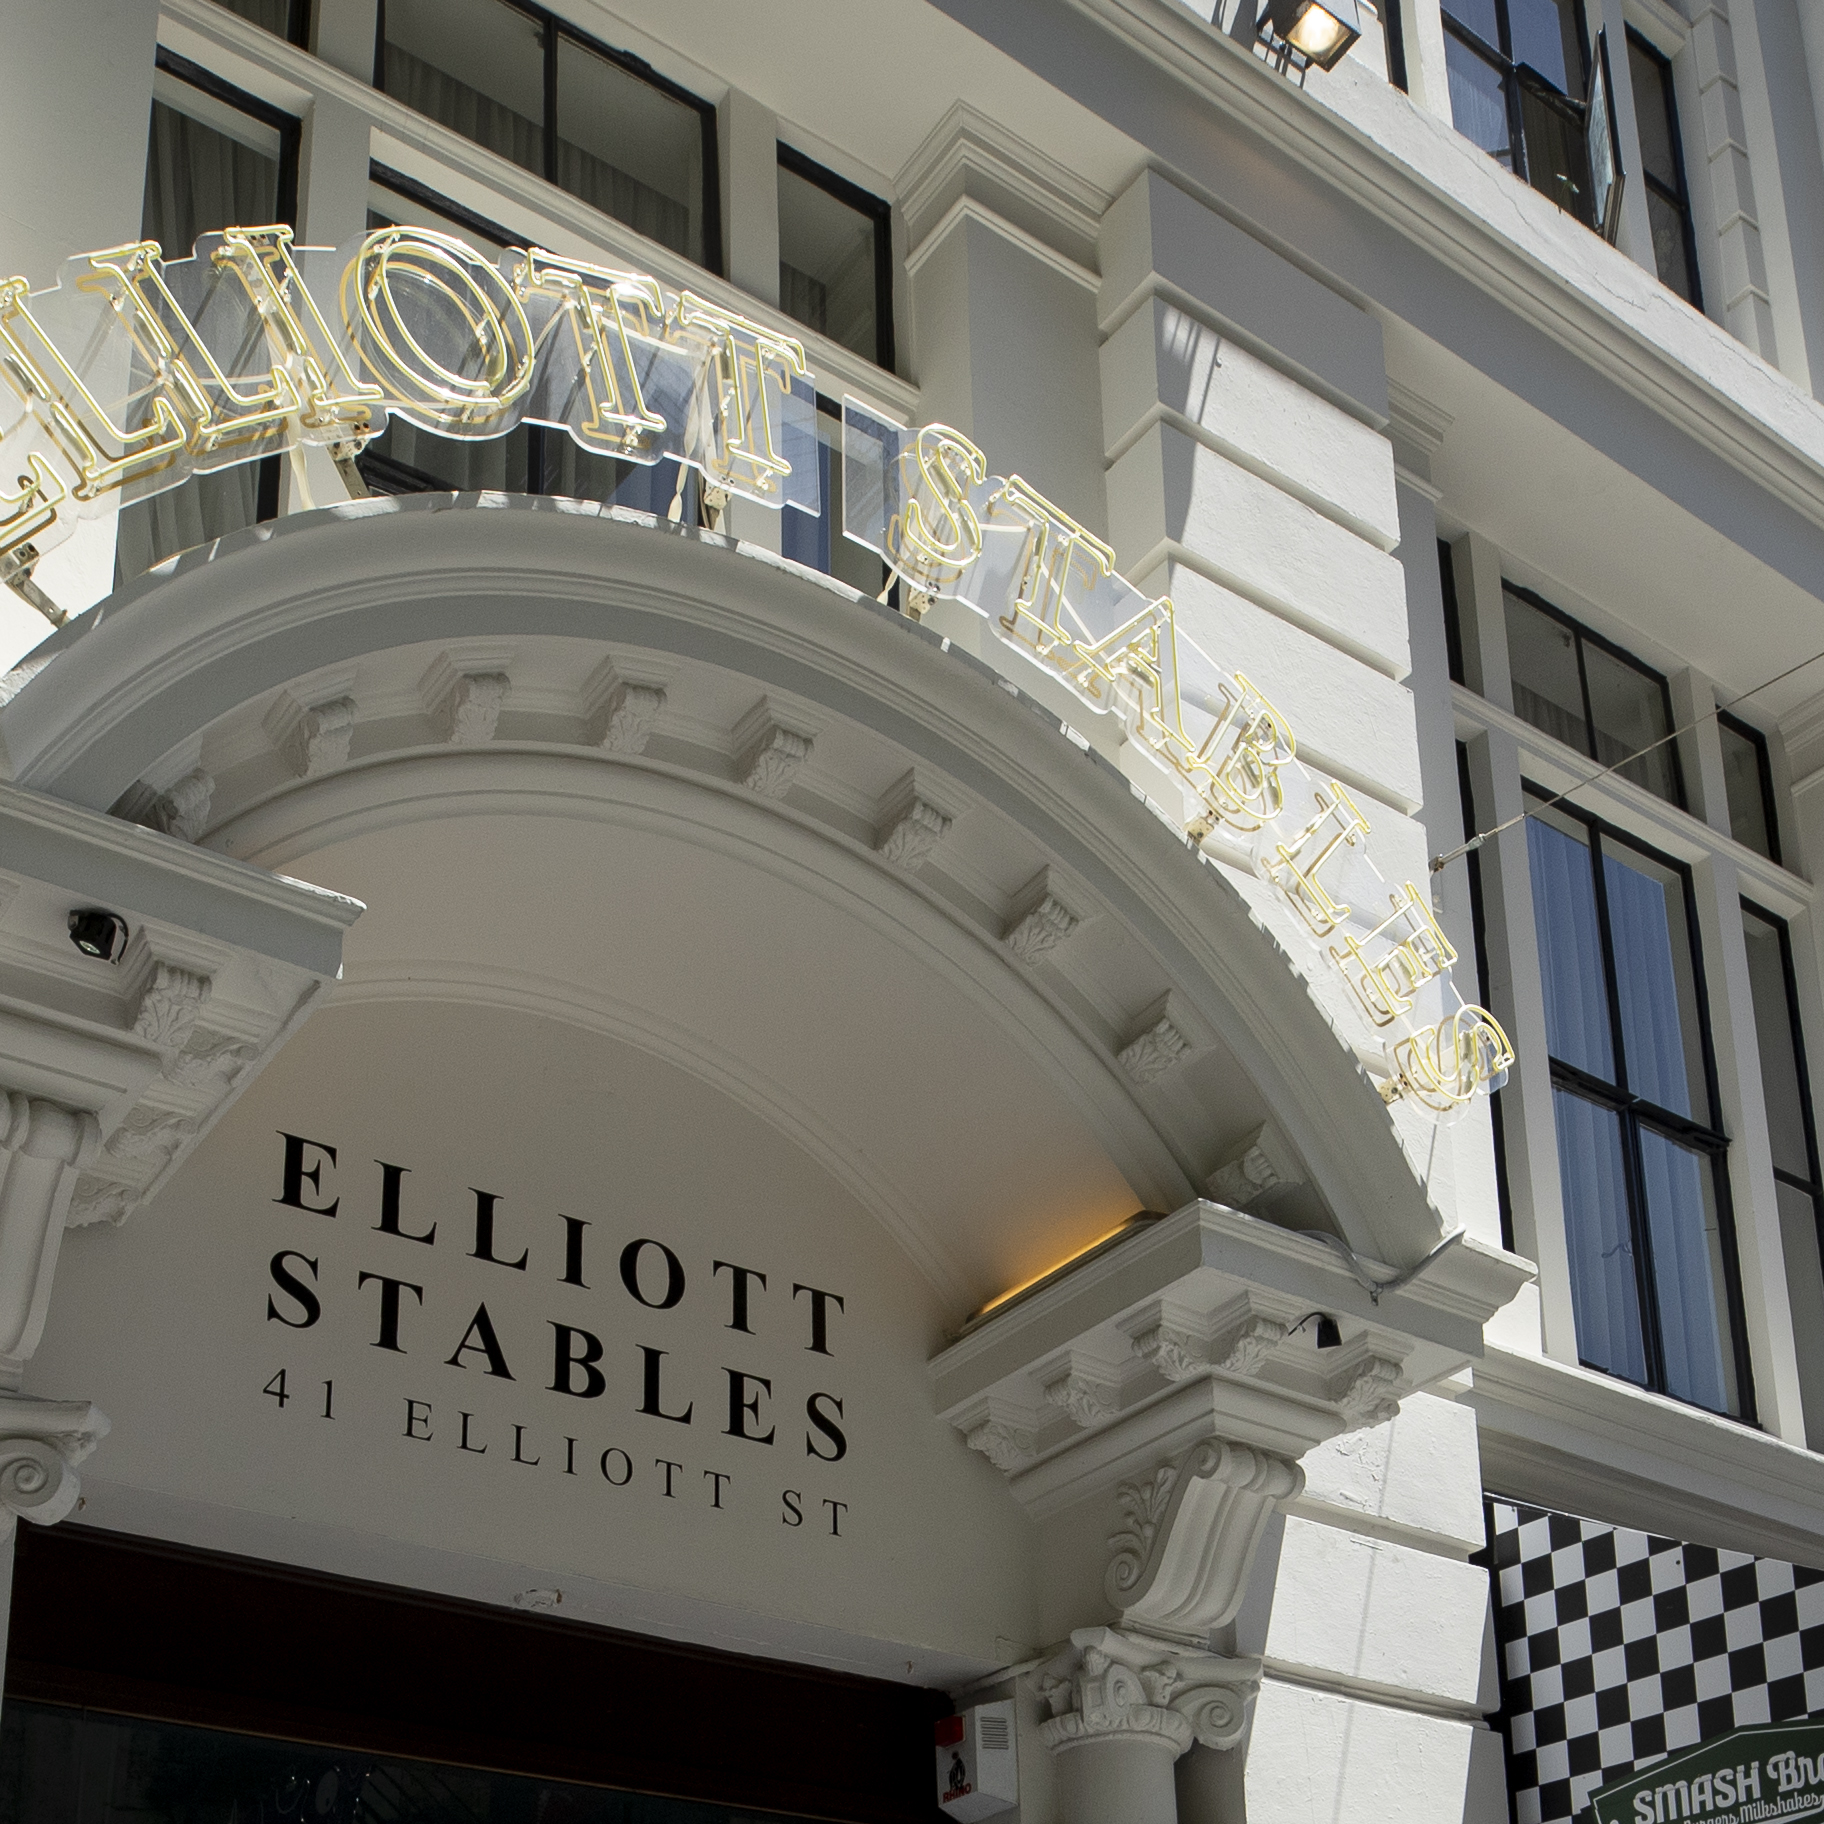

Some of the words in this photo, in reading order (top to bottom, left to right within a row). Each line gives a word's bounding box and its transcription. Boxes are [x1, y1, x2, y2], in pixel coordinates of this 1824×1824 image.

[890, 422, 1514, 1118] STABLES
[272, 1129, 845, 1357] ELLIOTT
[266, 1250, 849, 1462] STABLES
[263, 1368, 336, 1419] 41
[402, 1398, 731, 1511] ELLIOTT
[781, 1489, 848, 1537] ST
[943, 1783, 971, 1803] RHINO
[1739, 1791, 1823, 1824] Milkshakes
